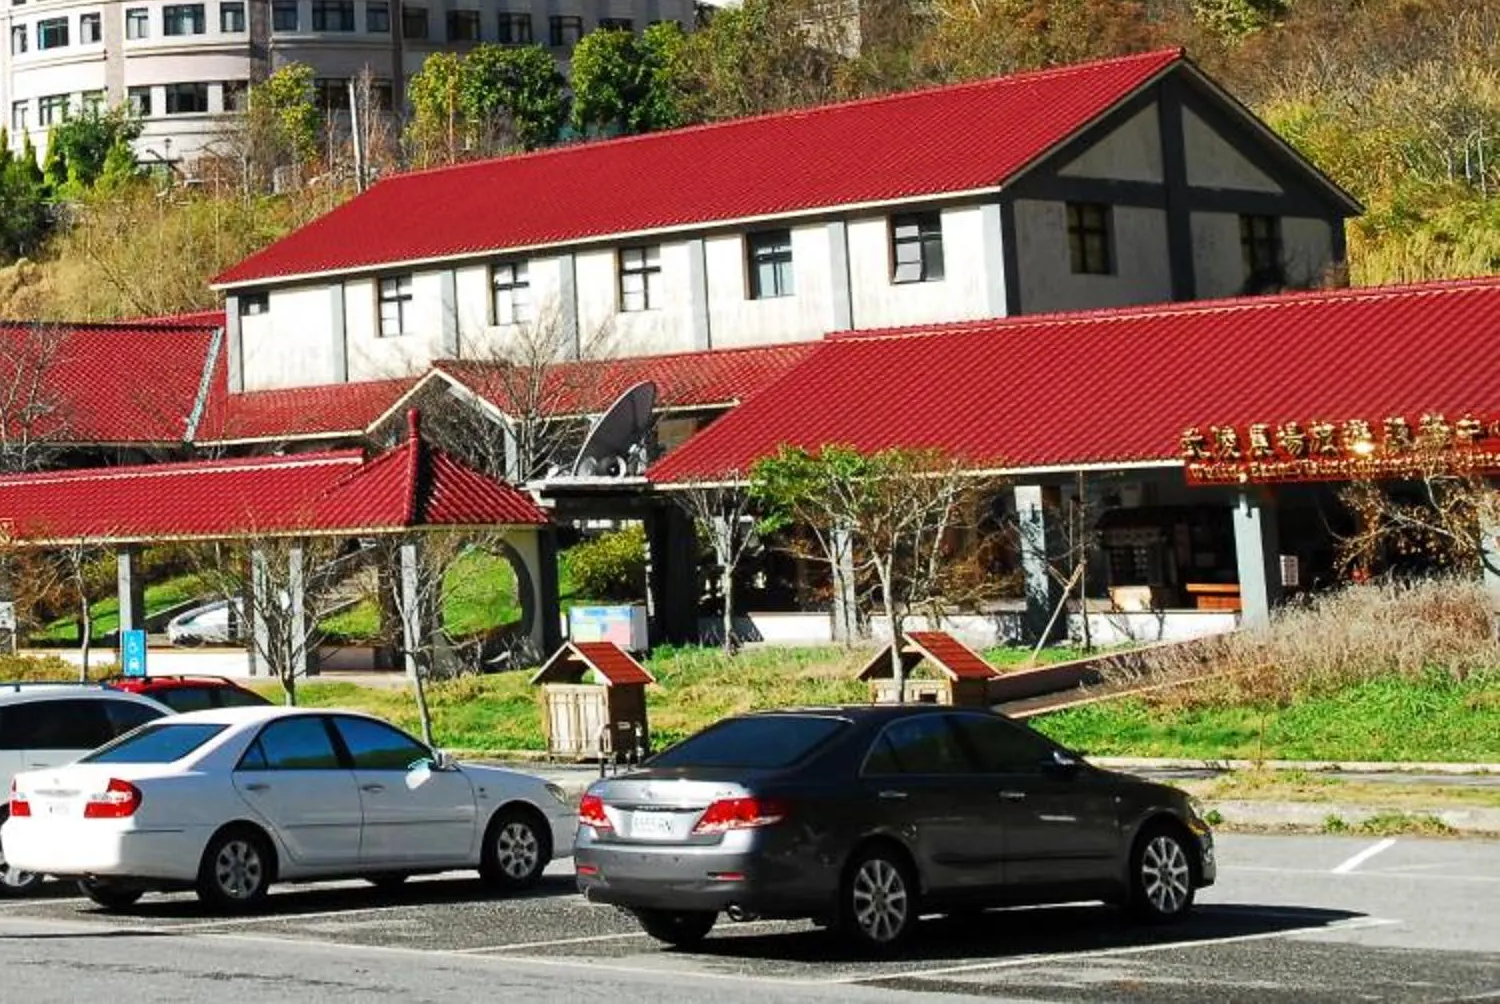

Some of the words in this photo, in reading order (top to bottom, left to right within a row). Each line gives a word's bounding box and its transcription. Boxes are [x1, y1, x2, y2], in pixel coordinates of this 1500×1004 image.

[1180, 413, 1499, 460] 武陵農場旅遊服務中
